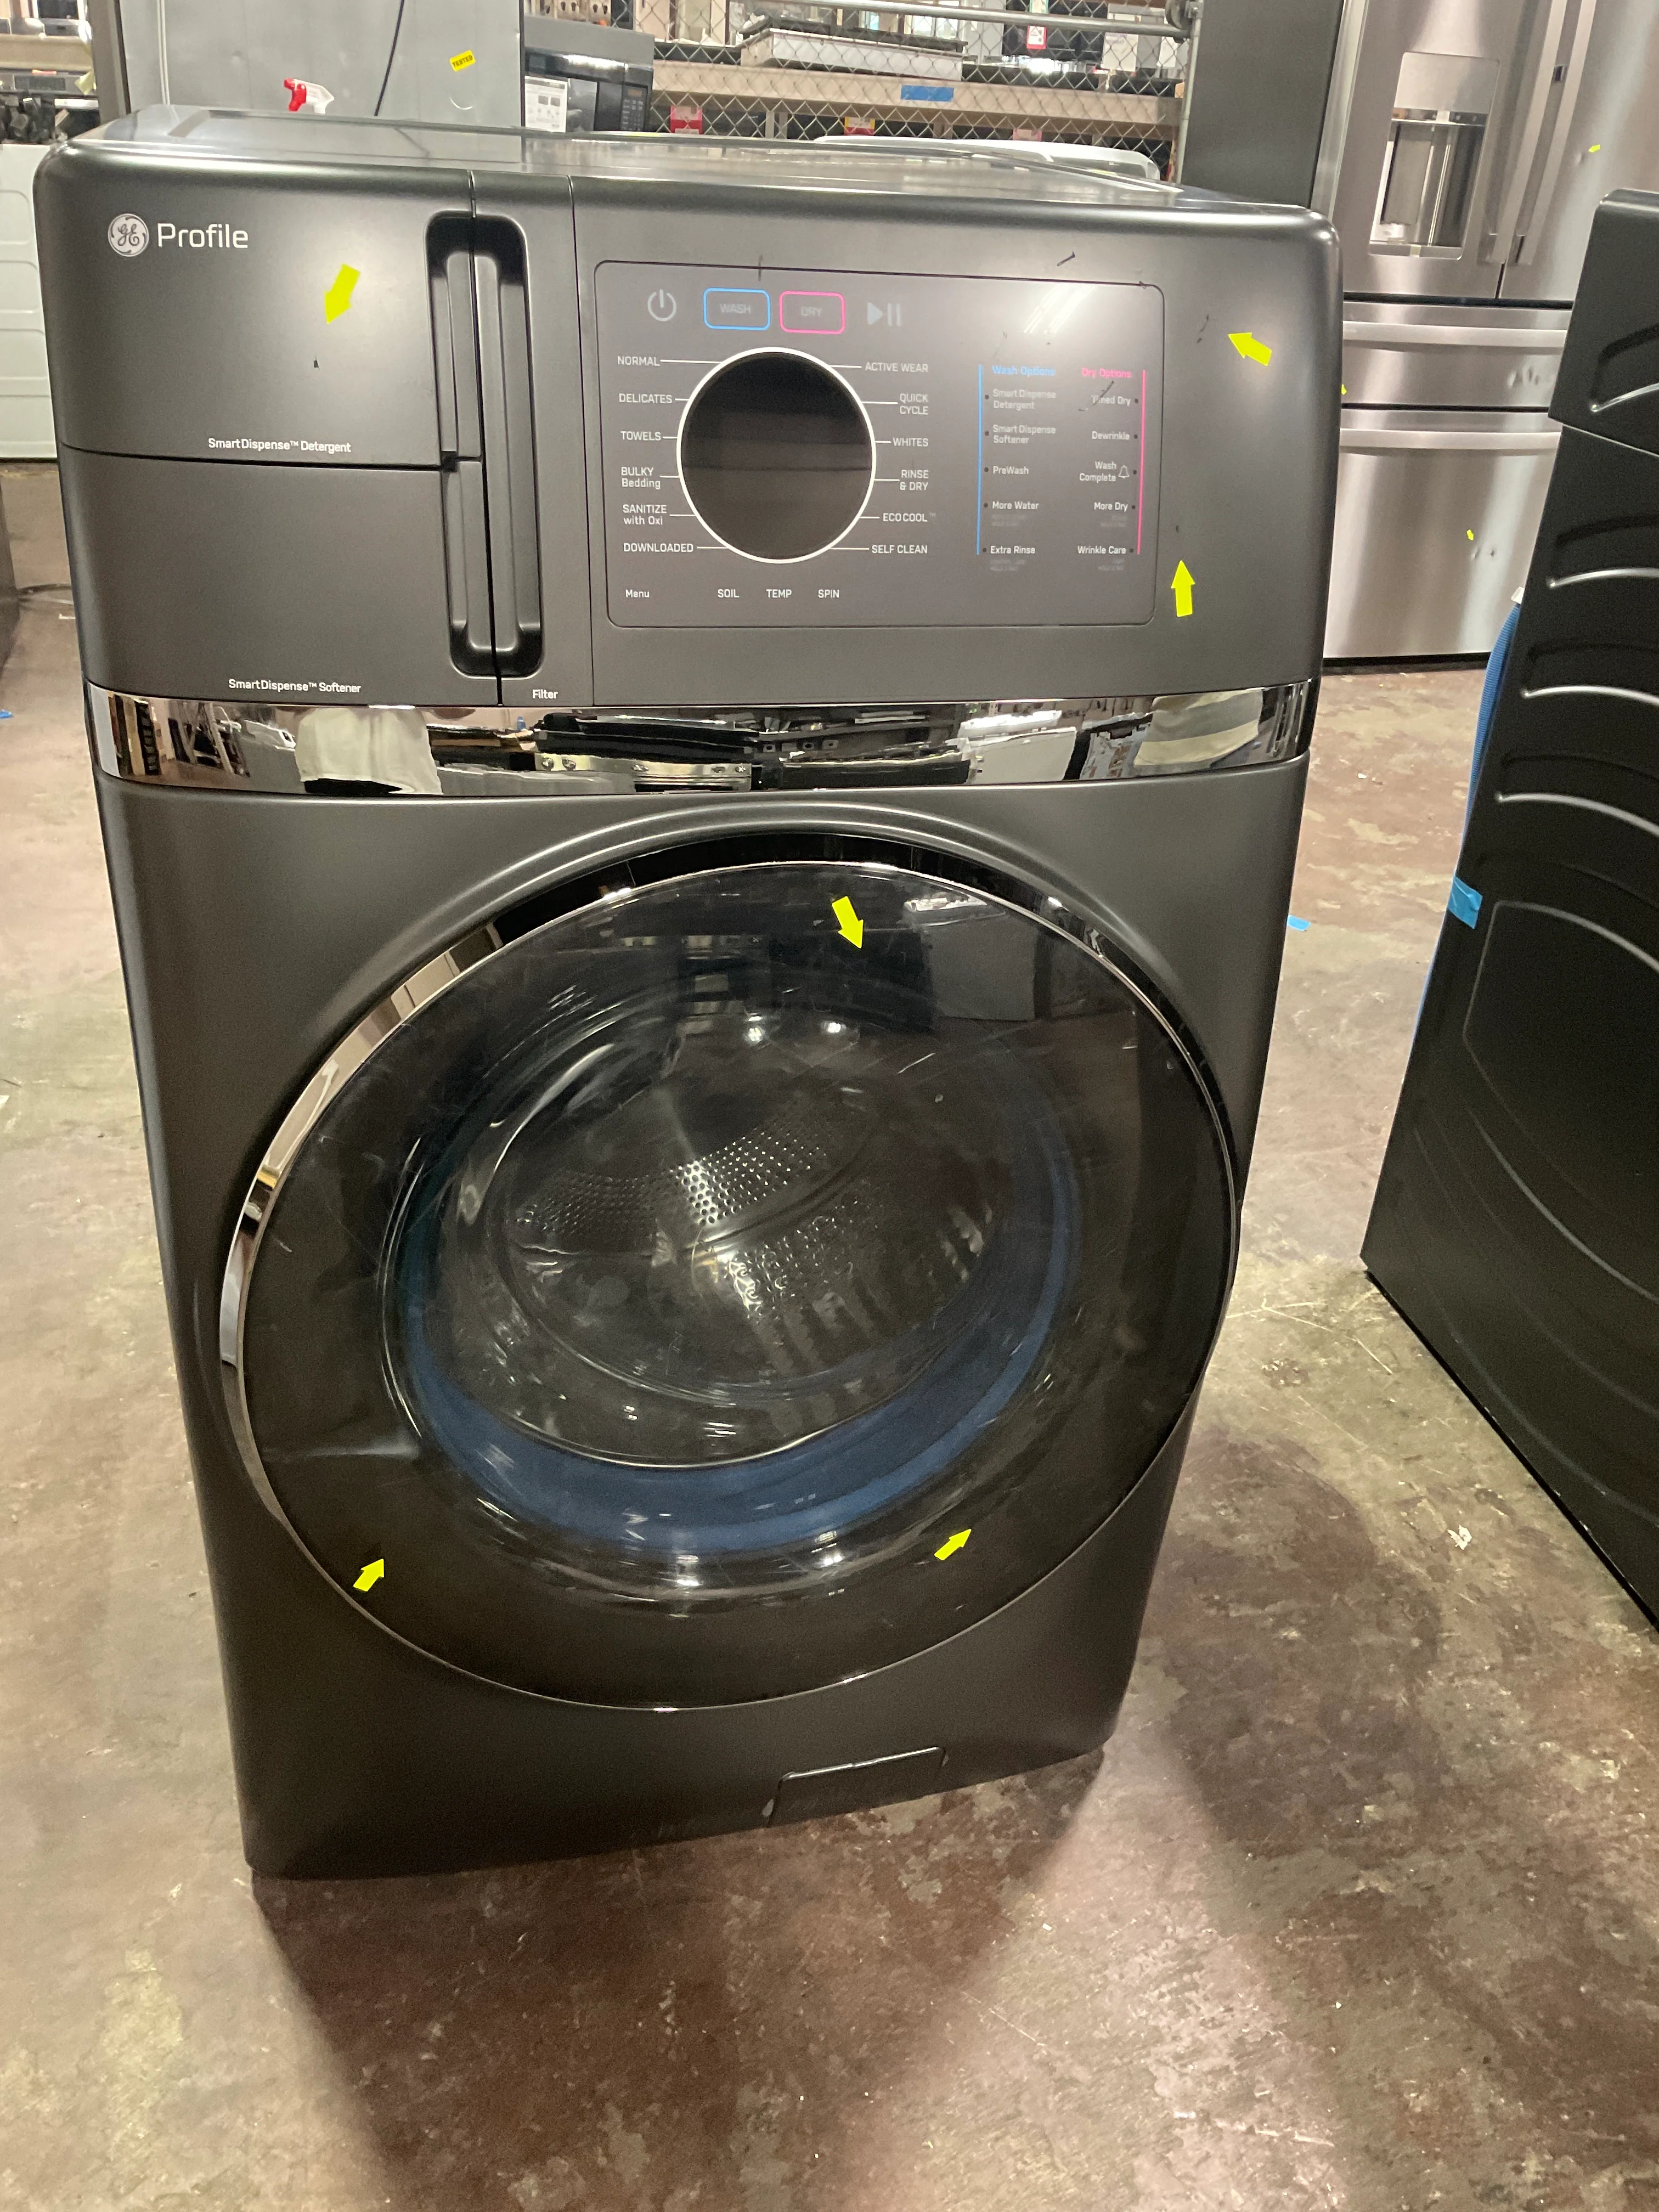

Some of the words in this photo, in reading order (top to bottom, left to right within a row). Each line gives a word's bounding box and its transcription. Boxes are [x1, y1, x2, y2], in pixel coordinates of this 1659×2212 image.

[452, 54, 473, 67] TESTED
[157, 223, 249, 248] Profile
[720, 303, 751, 314] WASH
[800, 306, 822, 317] DRY
[617, 356, 661, 366] NORMAL
[865, 362, 898, 371] ACTIVE
[901, 363, 928, 373] WEAR
[992, 365, 1018, 375] Wash
[1020, 366, 1056, 377] Options
[1081, 368, 1097, 379] Dry
[1099, 368, 1132, 379] Options
[619, 393, 672, 404] DELICATES
[900, 393, 928, 403] QUICK
[1118, 396, 1131, 407] Dry
[900, 405, 929, 415] CYCLE
[993, 400, 1035, 411] Detergent
[620, 431, 661, 441] TOWELS
[994, 435, 1029, 444] Softener
[1092, 431, 1130, 440] Dewrinkle
[301, 440, 351, 454] Detergent
[893, 437, 928, 447] WHITES
[993, 466, 1029, 475] PreWash
[1095, 461, 1116, 470] Wash
[621, 466, 654, 476] BULKY
[901, 470, 929, 478] RINSE
[1079, 473, 1116, 483] Complete
[622, 478, 661, 489] Bedding
[900, 482, 906, 490] &
[909, 482, 928, 490] DRY
[623, 504, 667, 514] SANITIZE
[992, 501, 1012, 510] More
[1014, 501, 1039, 510] Water
[1094, 502, 1113, 510] More
[1115, 502, 1128, 512] Dry
[623, 516, 645, 524] with
[648, 516, 663, 524] Oxi
[623, 543, 693, 552] DOWNLOADED
[872, 545, 895, 554] SELF
[897, 545, 928, 554] CLEAN
[990, 545, 1012, 554] Extra
[1014, 545, 1036, 554] Rinse
[1077, 546, 1106, 554] Wrinkle
[1109, 546, 1126, 554] Care
[625, 589, 650, 598] Menu
[718, 589, 739, 598] SOIL
[766, 589, 792, 599] TEMP
[818, 589, 839, 599] SPIN
[319, 682, 361, 693] Softener
[532, 689, 558, 699] Filter
